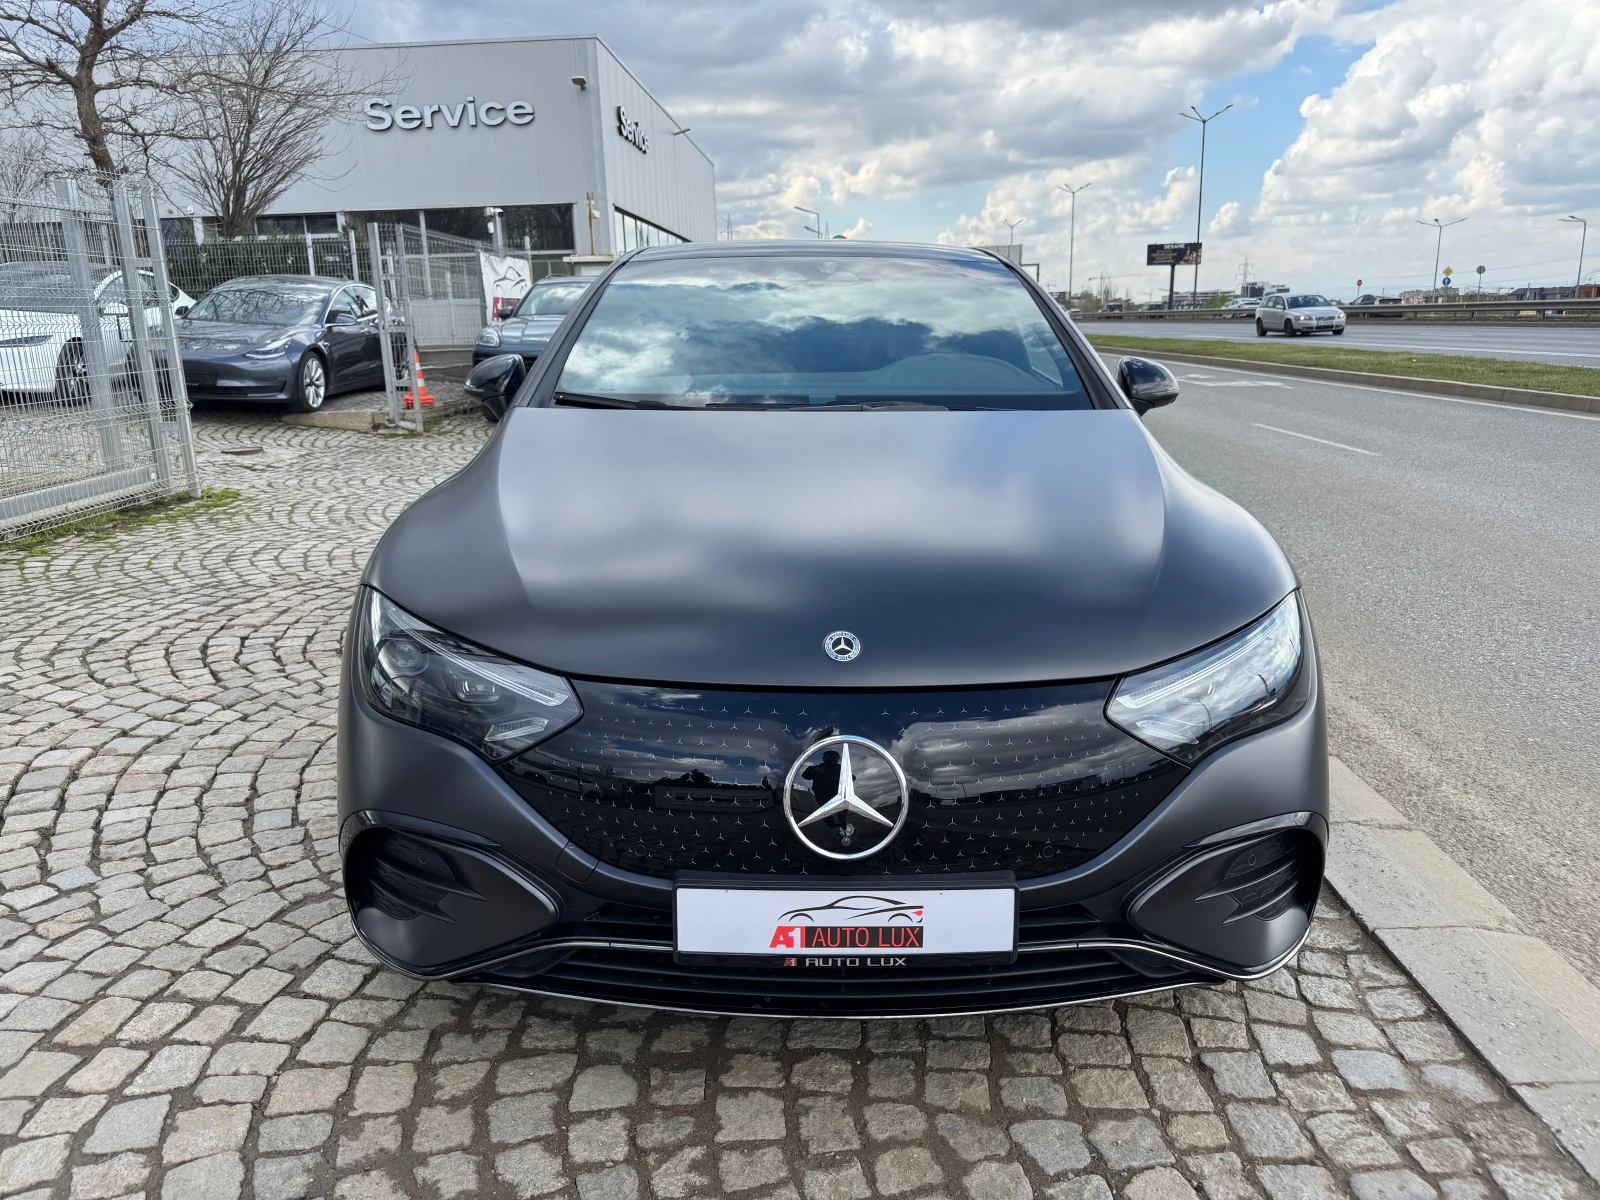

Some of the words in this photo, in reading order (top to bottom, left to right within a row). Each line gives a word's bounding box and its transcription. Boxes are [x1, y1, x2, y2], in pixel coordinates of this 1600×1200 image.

[362, 96, 535, 131] Service
[616, 105, 650, 154] Service
[769, 926, 806, 948] A1
[811, 927, 870, 948] AUTO
[878, 927, 920, 947] LUX
[783, 957, 797, 967] A1
[805, 957, 859, 967] AUTO
[867, 957, 907, 967] LUX
